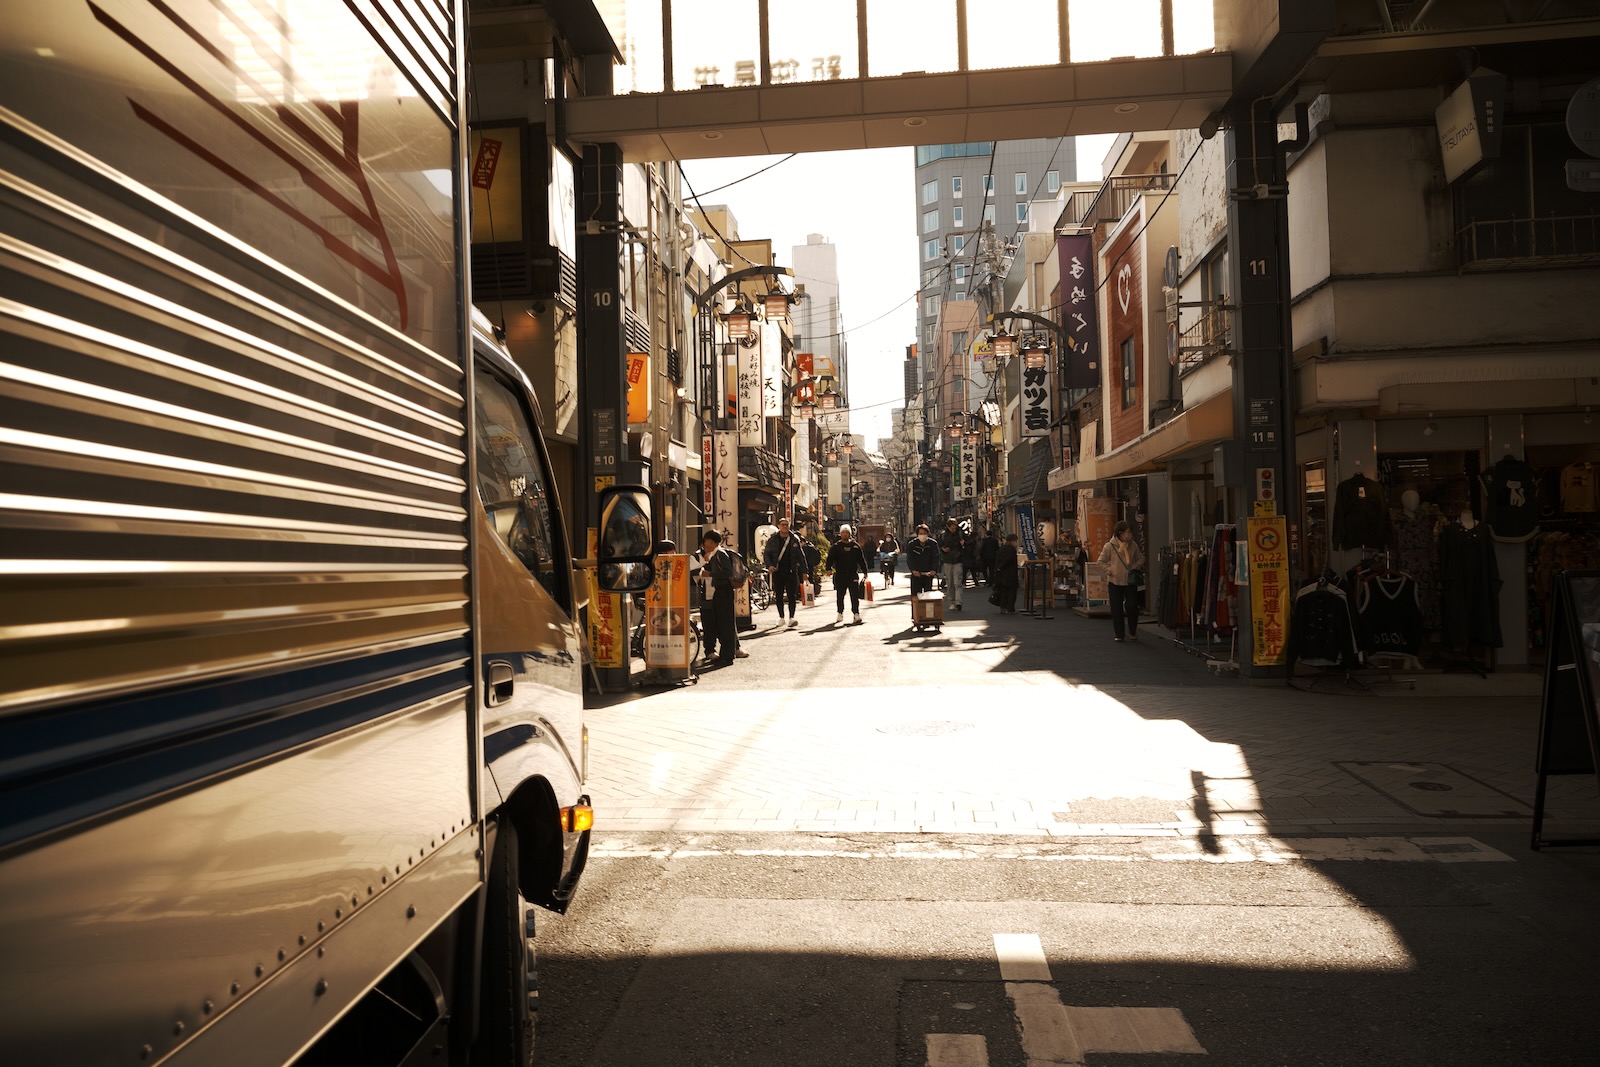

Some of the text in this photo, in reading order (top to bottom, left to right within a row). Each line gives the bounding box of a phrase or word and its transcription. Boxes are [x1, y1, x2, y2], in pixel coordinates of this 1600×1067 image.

[1444, 122, 1476, 151] TSUTAYA
[1249, 259, 1266, 276] 11
[593, 291, 611, 307] 10
[1023, 366, 1049, 430] カツ吉
[1252, 431, 1264, 443] 11
[603, 455, 615, 465] 10
[1262, 571, 1282, 657] 車両進入禁止
